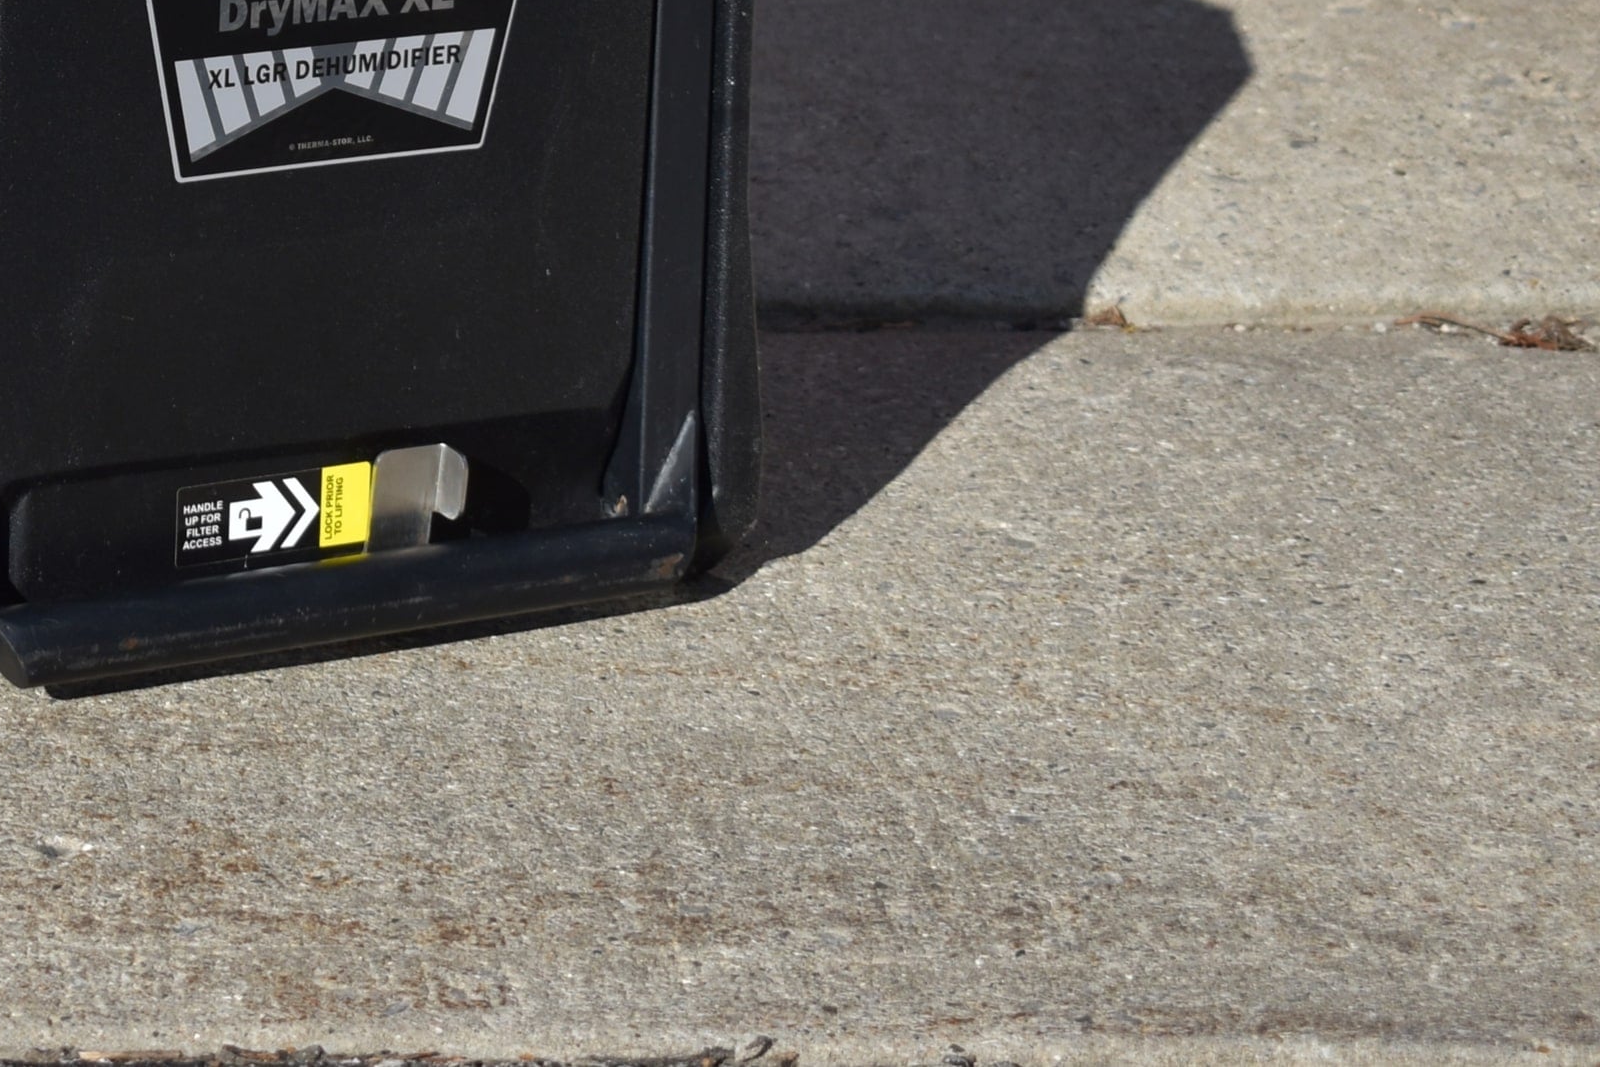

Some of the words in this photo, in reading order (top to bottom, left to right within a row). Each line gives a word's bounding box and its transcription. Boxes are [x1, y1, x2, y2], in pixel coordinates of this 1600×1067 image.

[208, 67, 236, 90] XL
[244, 60, 287, 86] LGR
[295, 44, 462, 80] DEHUMIDIFIER
[325, 474, 335, 510] PRIOR
[334, 477, 344, 518] LIFTING
[183, 500, 224, 515] HANDLE
[185, 515, 199, 527] UP
[200, 512, 221, 525] FOR
[324, 512, 333, 540] LOCK
[334, 519, 342, 535] TO
[186, 525, 220, 538] FILTER
[183, 536, 222, 550] ACCESS
